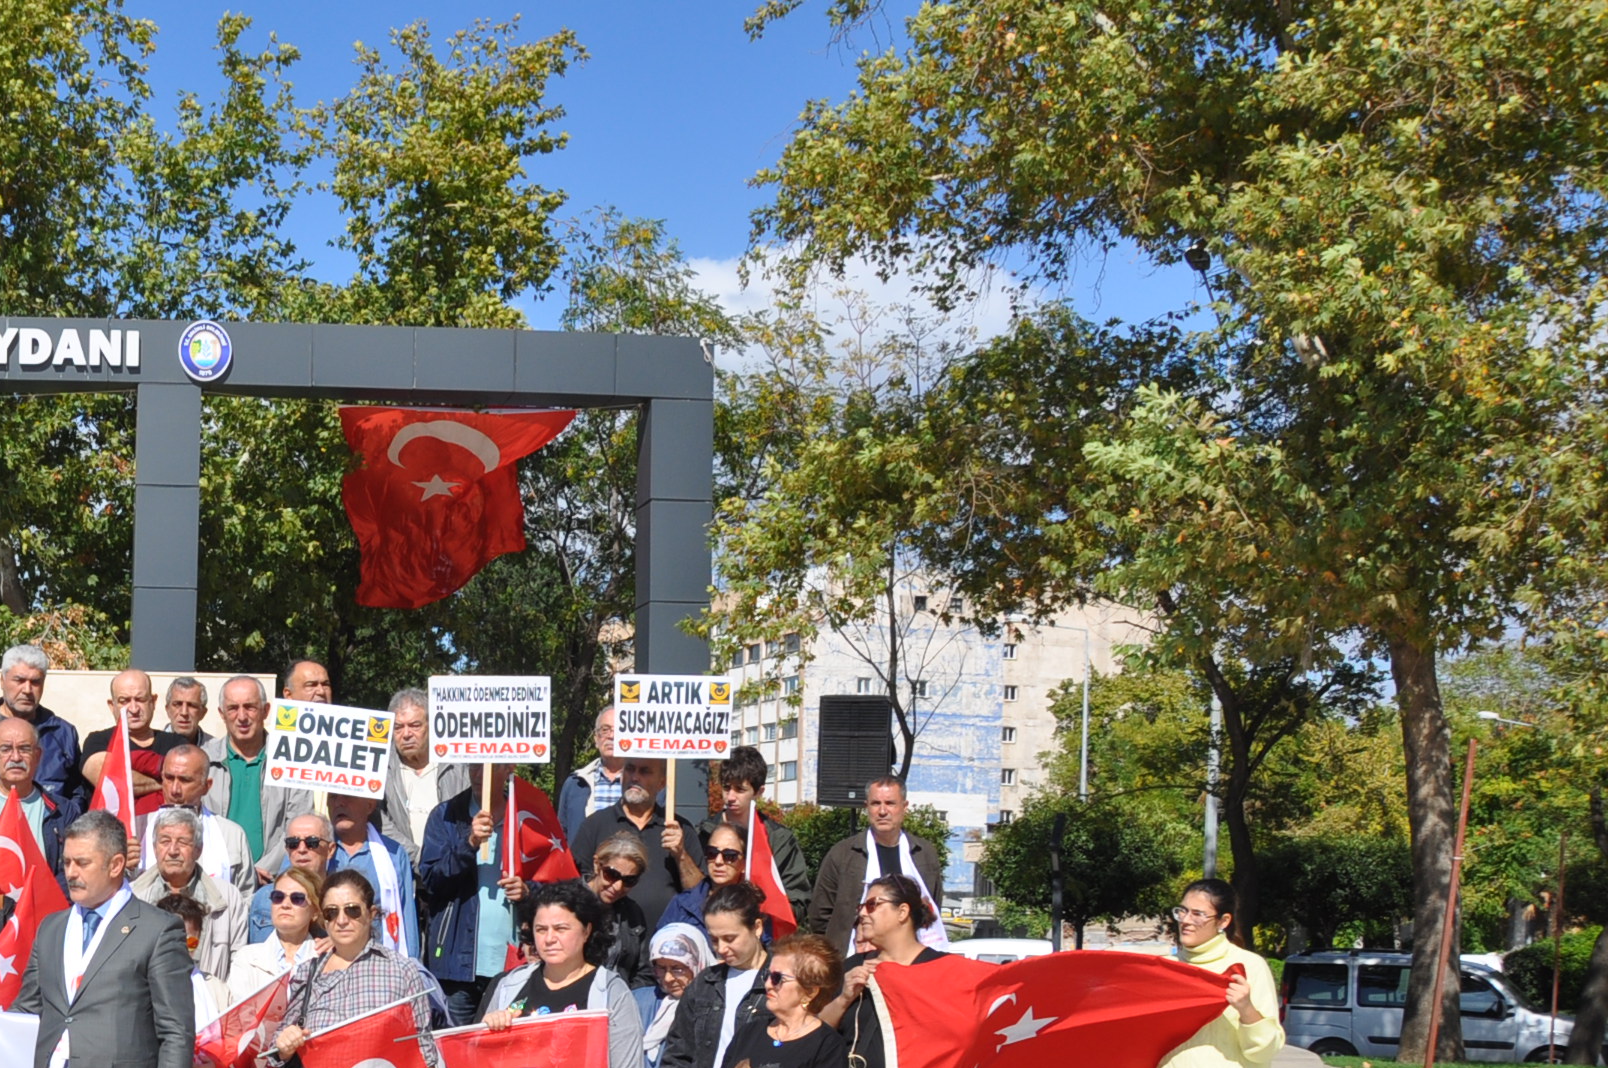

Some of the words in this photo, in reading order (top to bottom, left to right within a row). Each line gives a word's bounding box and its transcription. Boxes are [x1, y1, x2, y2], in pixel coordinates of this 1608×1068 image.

[473, 683, 510, 702] ÖDENMEZ
[647, 681, 703, 705] ARTIK
[298, 707, 366, 741] ÖNCE
[434, 705, 546, 738] ÖDEMEDİNİZ!
[618, 706, 729, 735] SUSMAYACAĞIZ!
[272, 735, 387, 773] ADALET
[449, 742, 531, 754] TEMAD
[633, 738, 712, 750] TEMAD
[285, 766, 366, 787] TEMAD
